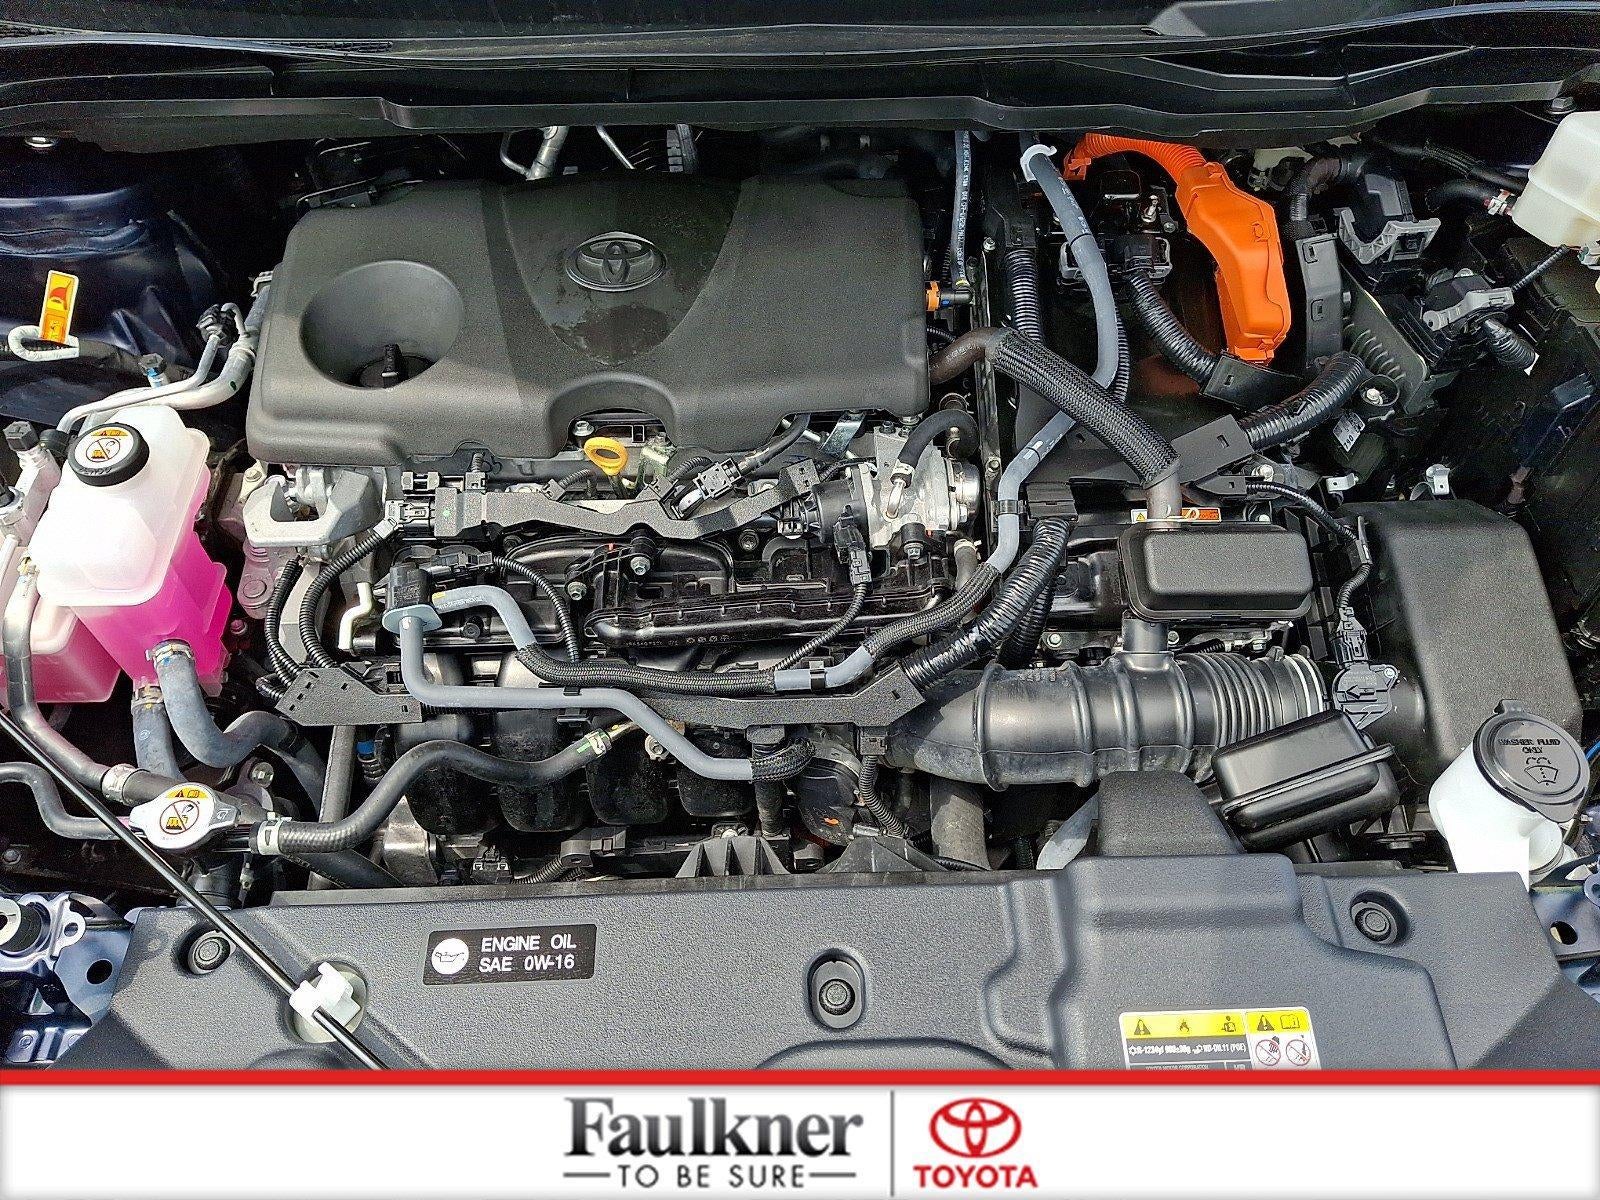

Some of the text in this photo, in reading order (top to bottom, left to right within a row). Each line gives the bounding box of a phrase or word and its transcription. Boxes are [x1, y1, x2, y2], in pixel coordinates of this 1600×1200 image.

[1499, 738, 1561, 746] WASHER FLUID
[1521, 746, 1543, 754] ONLY
[481, 933, 577, 953] ENGINE OIL
[478, 953, 575, 973] SAE 0W-16
